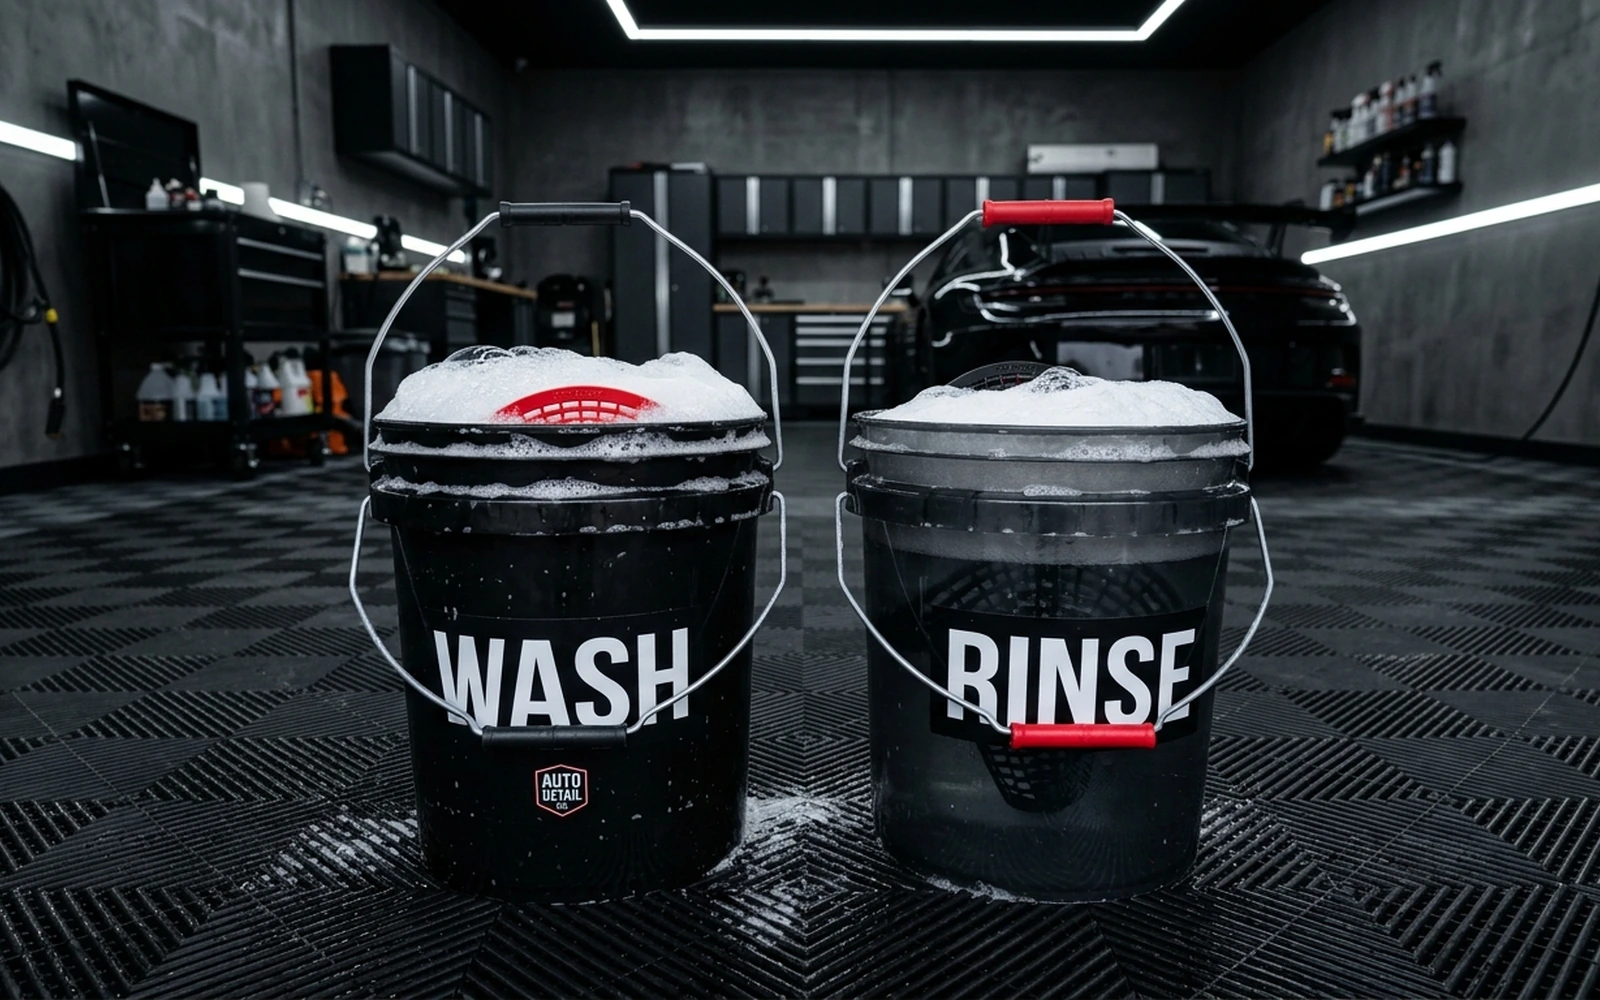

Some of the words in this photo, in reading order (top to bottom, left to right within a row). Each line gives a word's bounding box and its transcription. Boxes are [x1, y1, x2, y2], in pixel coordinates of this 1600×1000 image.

[433, 627, 689, 727] WASH
[947, 628, 1196, 726] RINSE
[542, 773, 581, 788] AUTO
